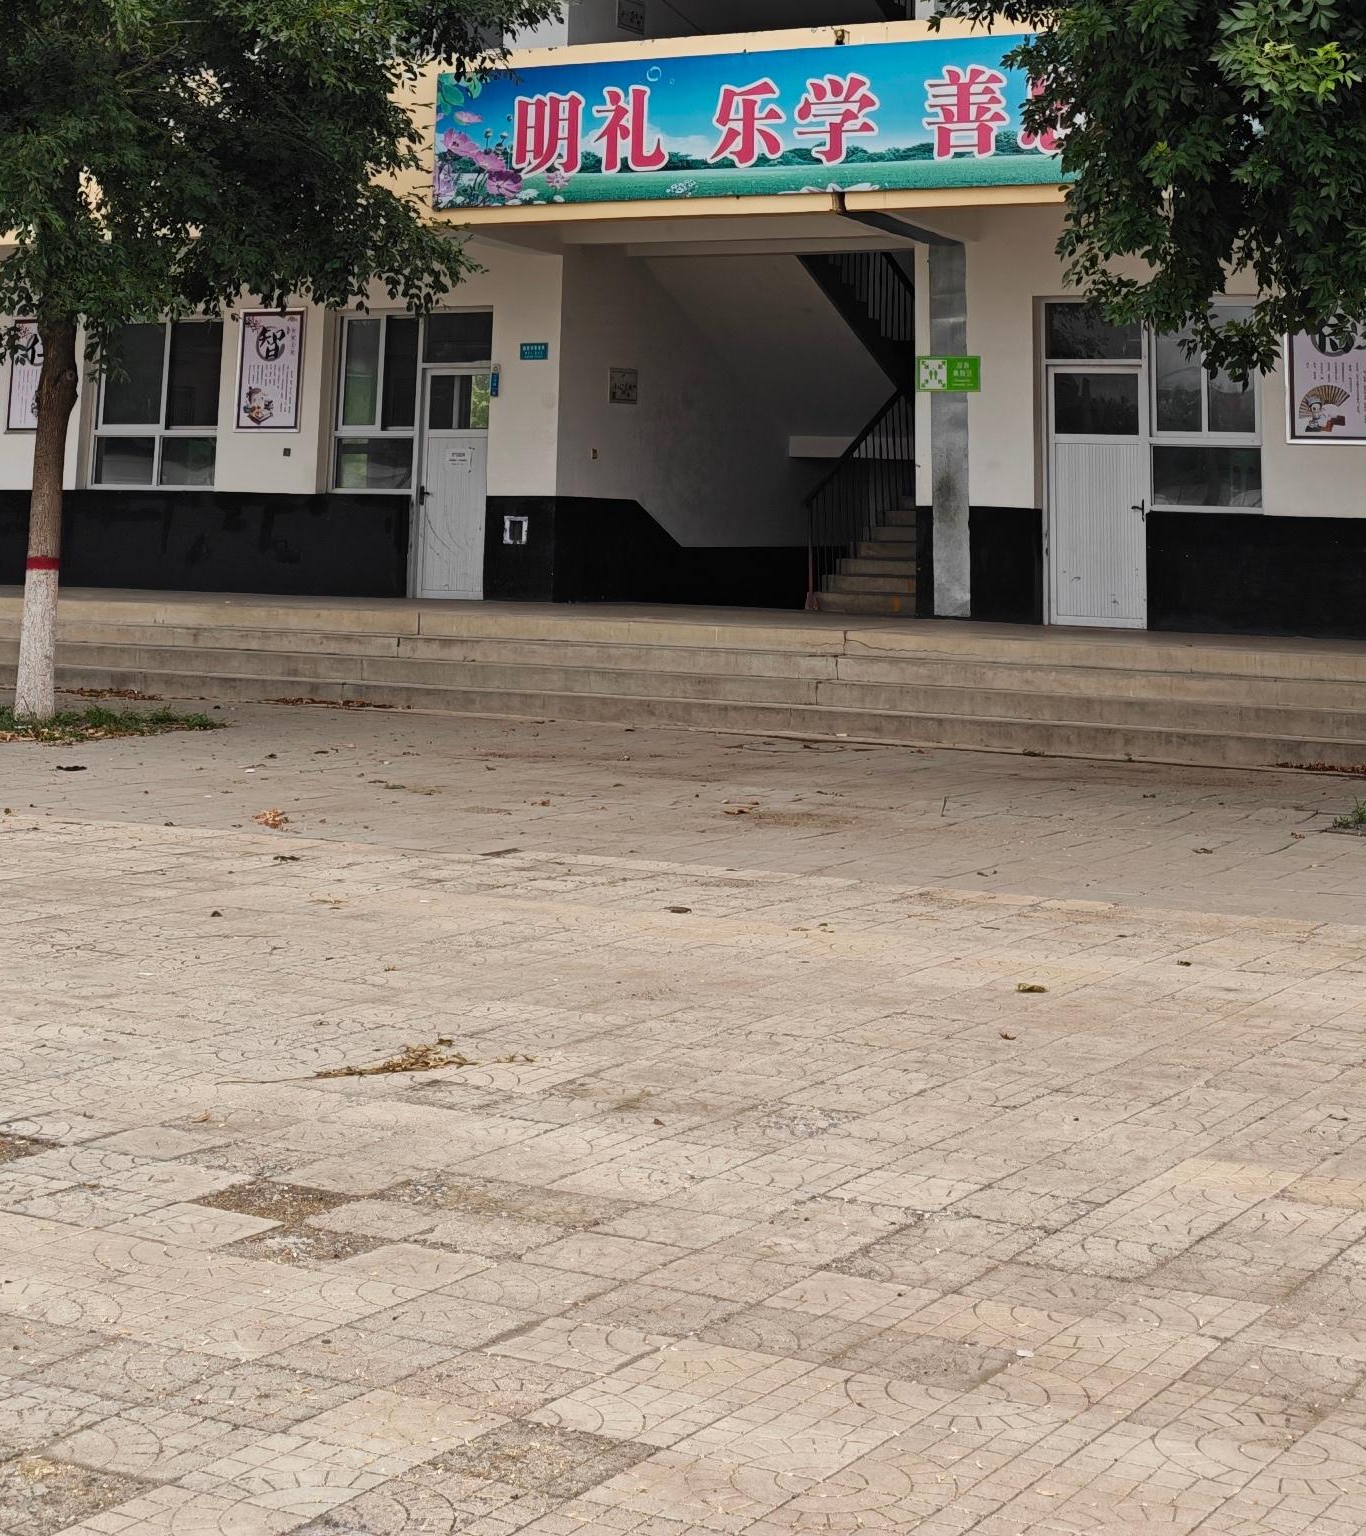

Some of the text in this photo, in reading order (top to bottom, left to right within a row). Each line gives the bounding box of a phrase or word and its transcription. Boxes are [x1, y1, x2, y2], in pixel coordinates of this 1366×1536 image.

[512, 84, 669, 176] 明礼
[708, 72, 880, 165] 乐学
[258, 325, 286, 360] 智
